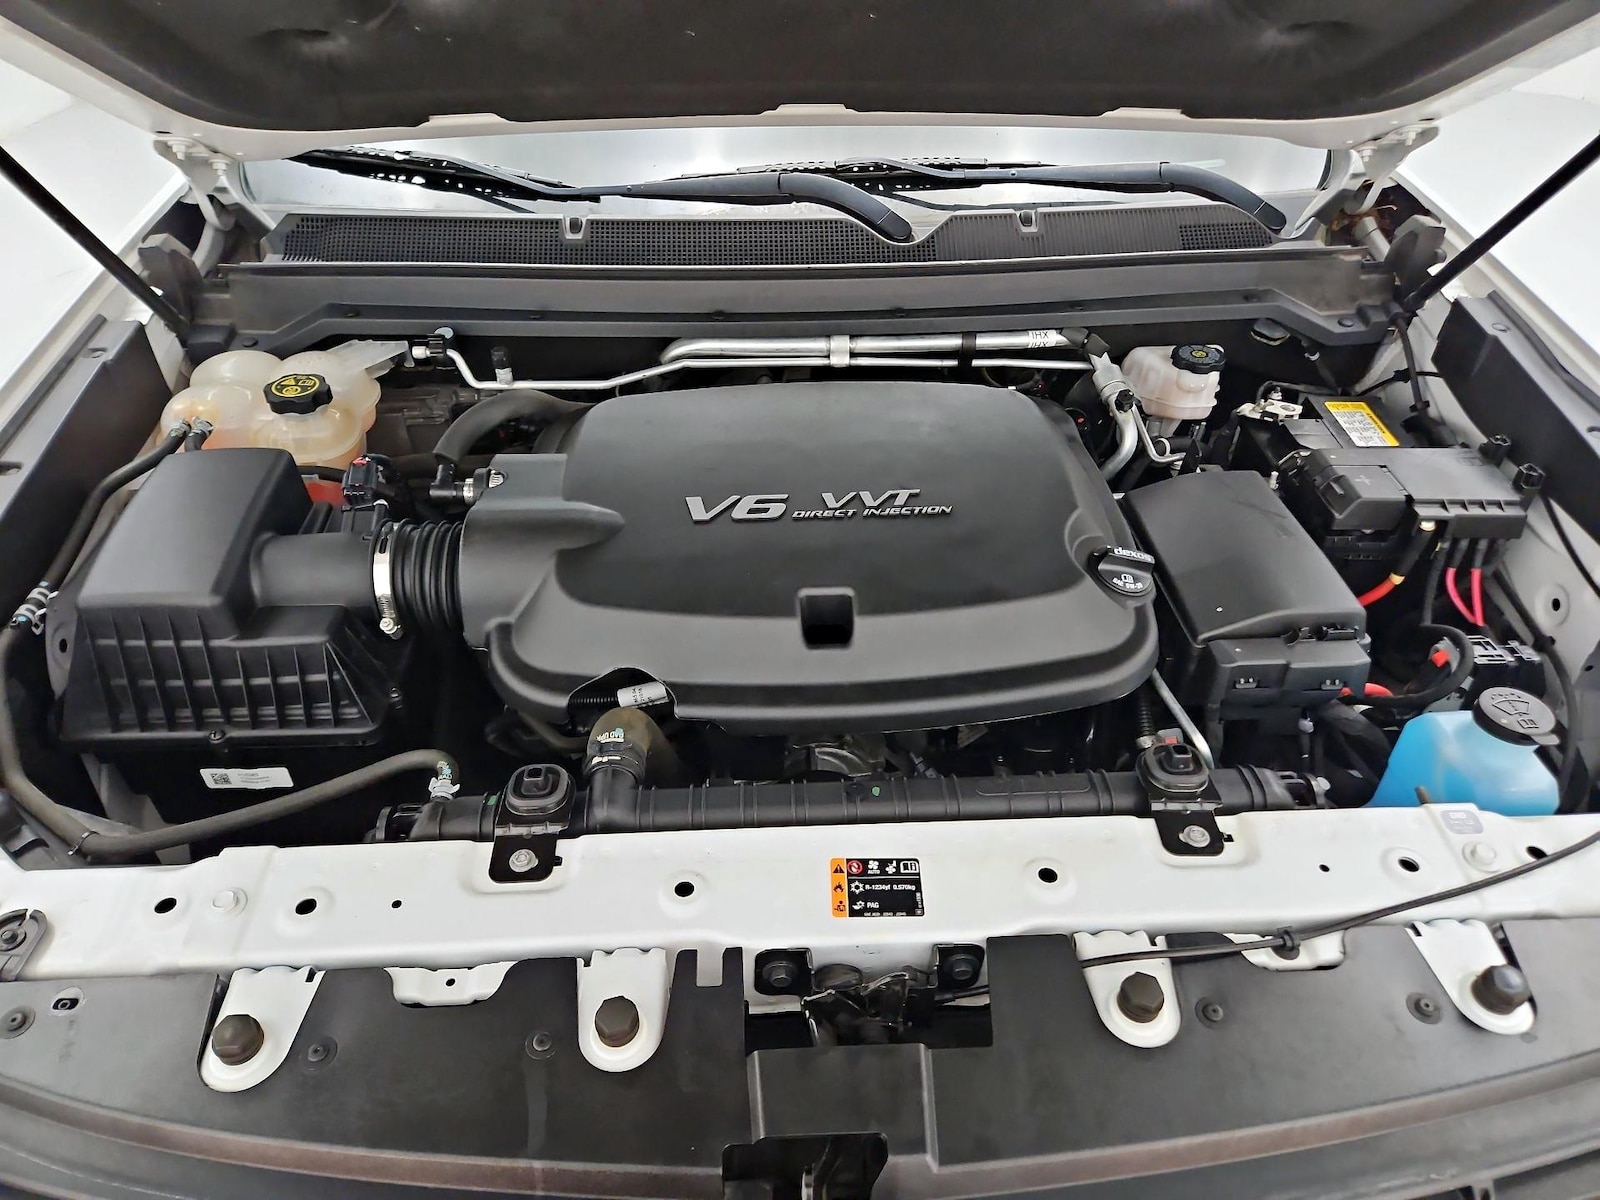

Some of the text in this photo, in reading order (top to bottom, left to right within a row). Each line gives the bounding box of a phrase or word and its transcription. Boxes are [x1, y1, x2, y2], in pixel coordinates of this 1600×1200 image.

[685, 488, 921, 521] V6 VVT
[792, 505, 953, 519] DIRECT INJECTION
